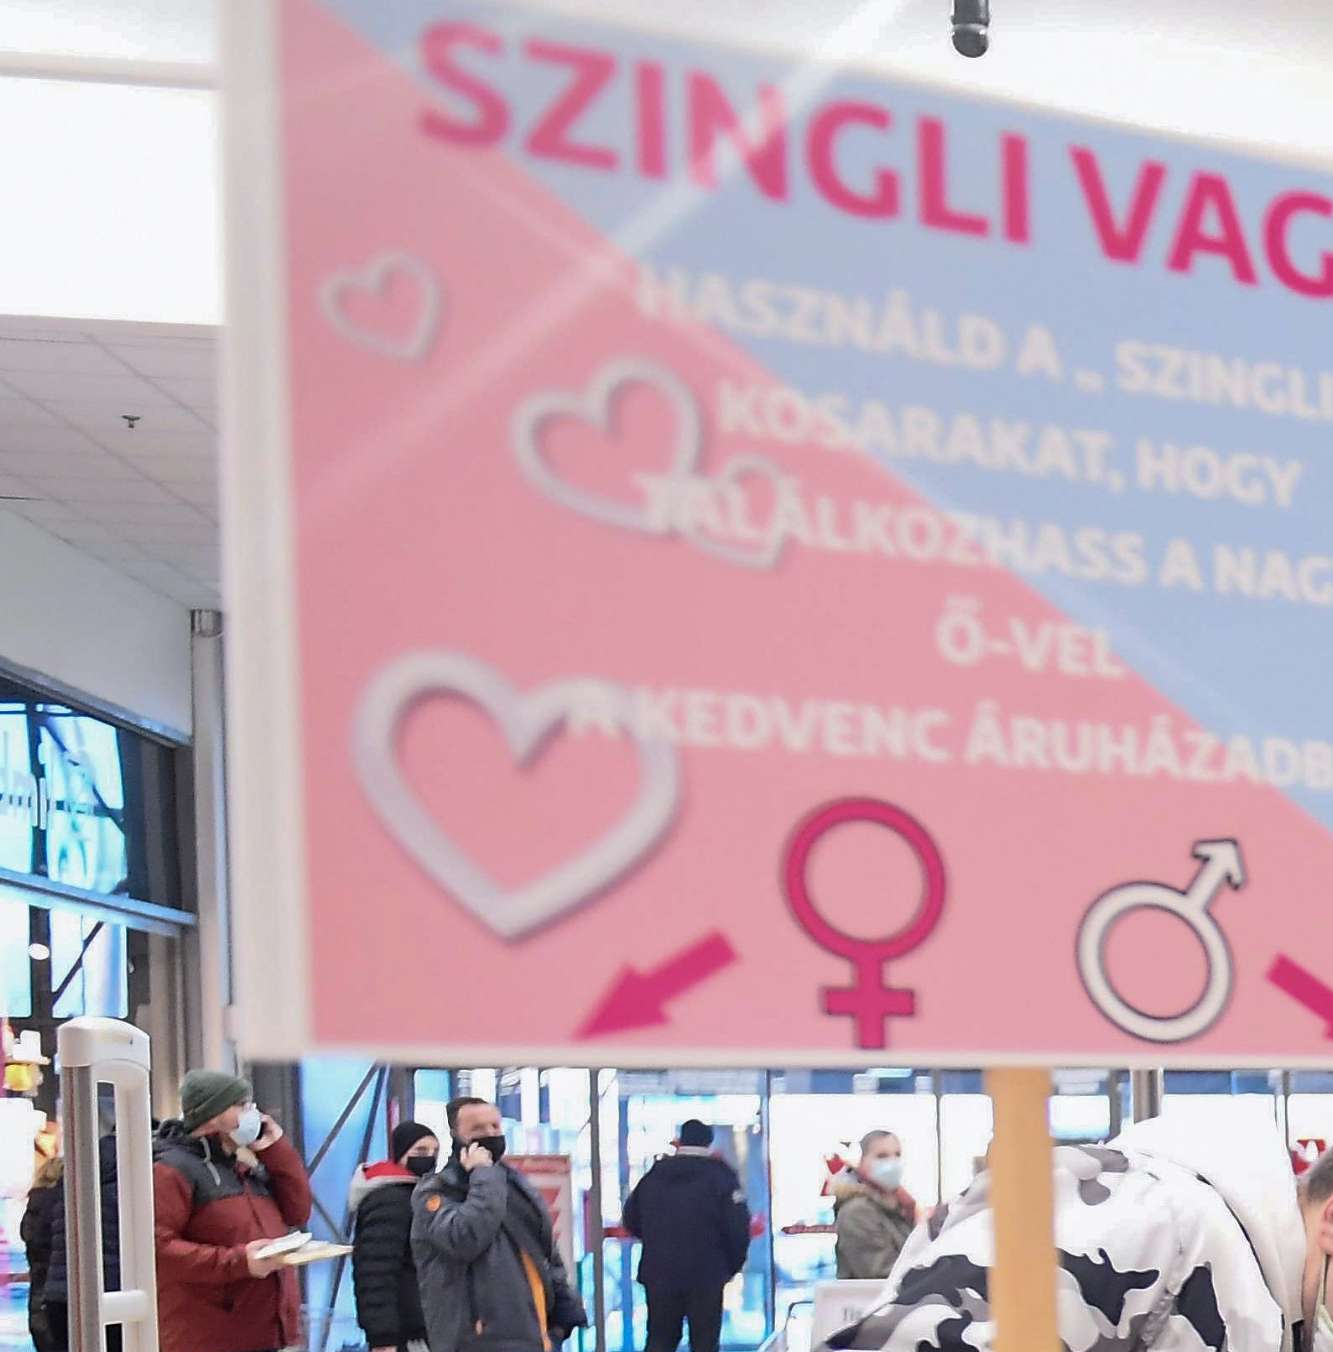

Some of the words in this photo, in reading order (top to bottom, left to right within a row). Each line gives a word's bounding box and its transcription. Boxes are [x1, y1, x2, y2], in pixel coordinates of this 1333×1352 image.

[416, 19, 1031, 247] SZINGLI
[636, 262, 1002, 369] HASZNÁLD
[1015, 324, 1064, 384] A
[717, 378, 1127, 494] KOSARAKAT,
[1135, 435, 1304, 510] HOGY
[1159, 536, 1205, 594] A
[632, 686, 954, 764] KEDVENC
